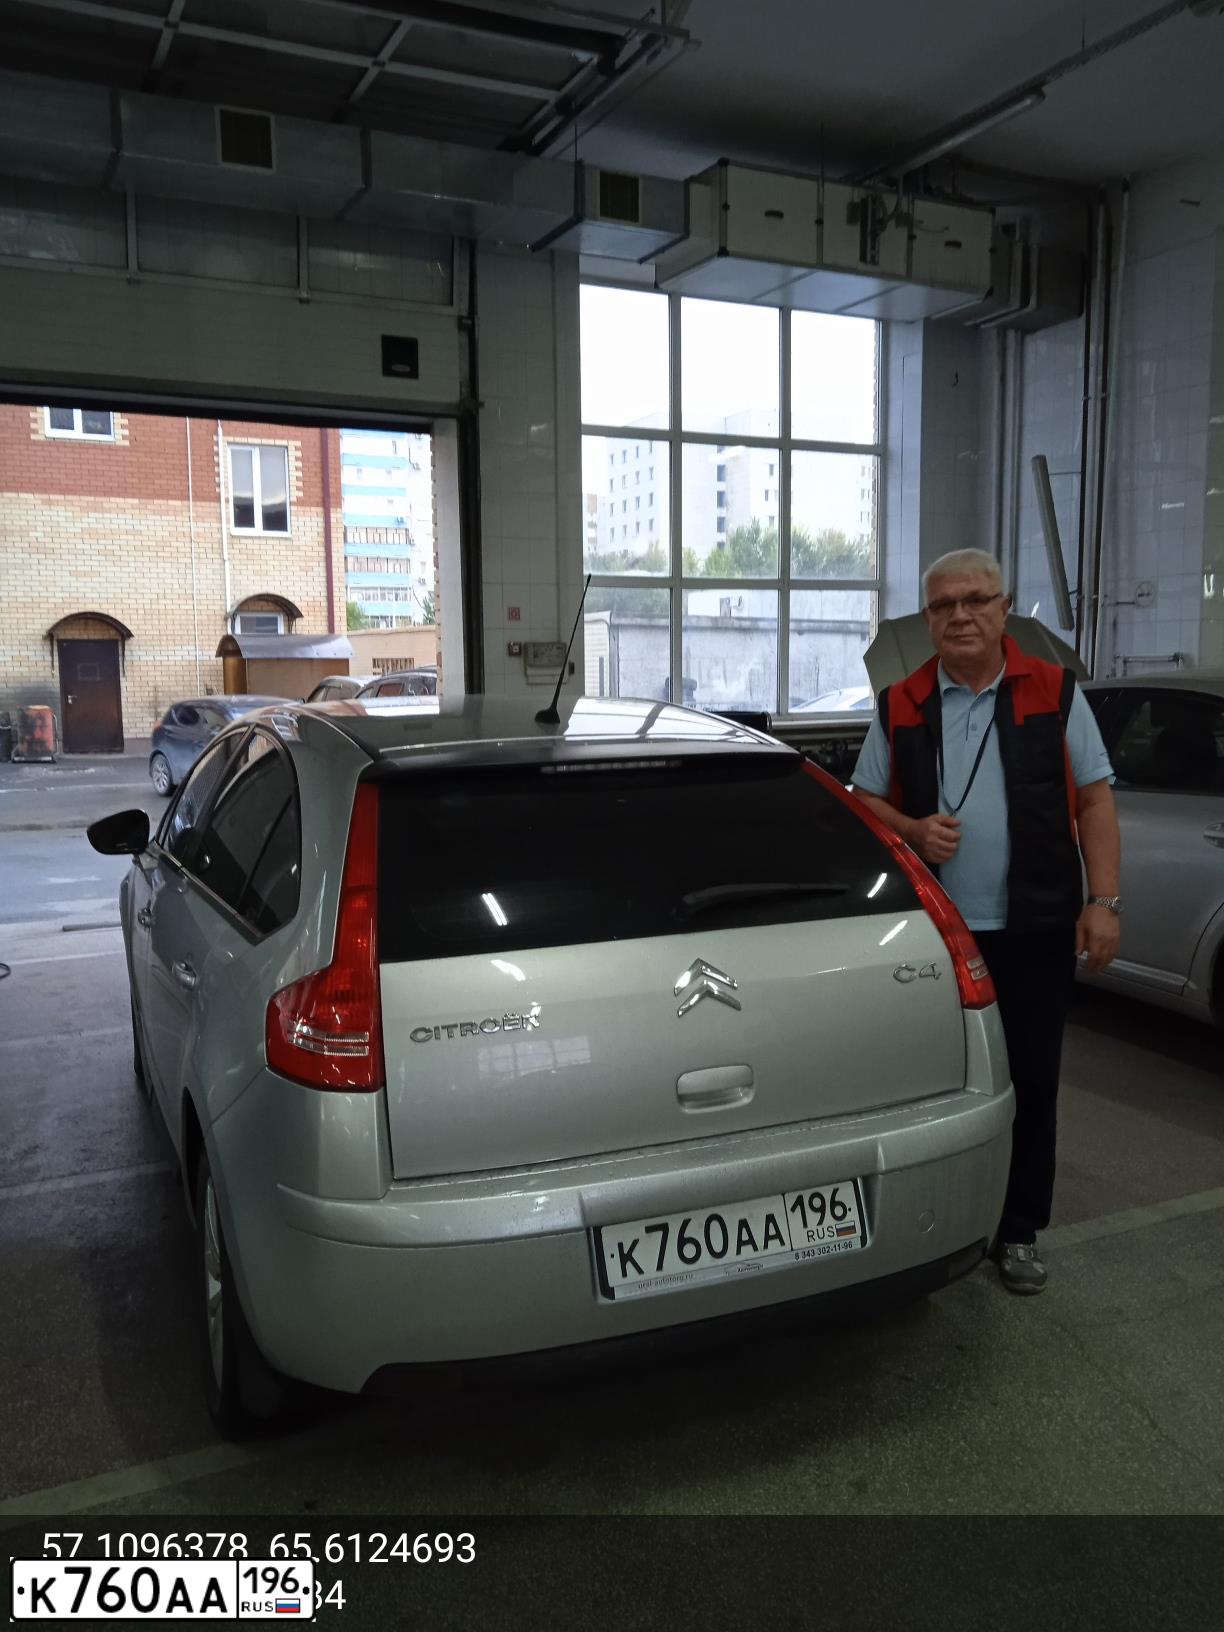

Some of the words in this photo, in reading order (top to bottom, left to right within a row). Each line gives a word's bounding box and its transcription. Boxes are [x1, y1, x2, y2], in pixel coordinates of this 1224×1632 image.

[892, 962, 942, 983] C4
[790, 1187, 848, 1229] 196
[806, 1227, 836, 1243] RUS
[802, 1249, 816, 1259] 343
[817, 1240, 853, 1256] 302-11-96
